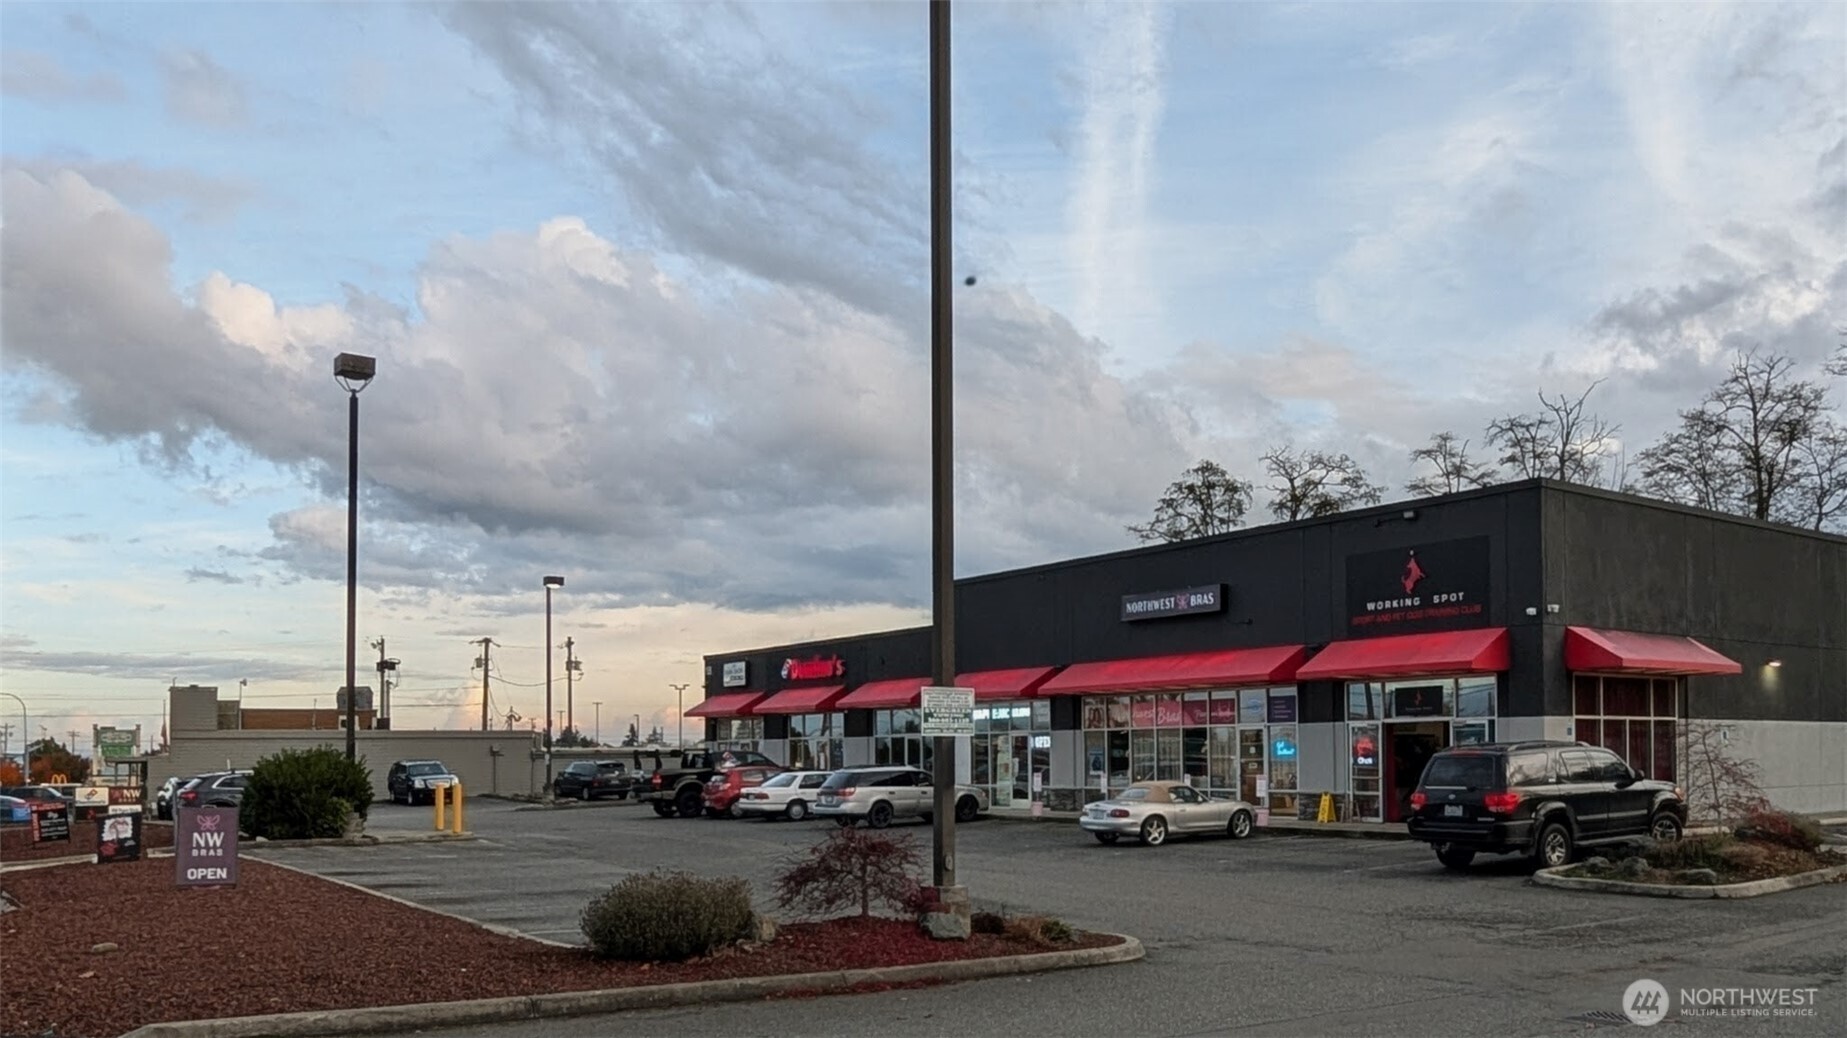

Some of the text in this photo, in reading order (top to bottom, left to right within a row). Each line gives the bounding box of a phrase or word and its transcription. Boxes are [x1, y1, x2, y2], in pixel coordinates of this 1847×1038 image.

[1126, 592, 1214, 613] NORTHWEST BRAS
[1366, 592, 1464, 611] WORKING SPOT
[122, 789, 141, 798] NW
[192, 831, 225, 848] NW
[191, 848, 224, 857] BRAS
[187, 867, 228, 880] OPEN
